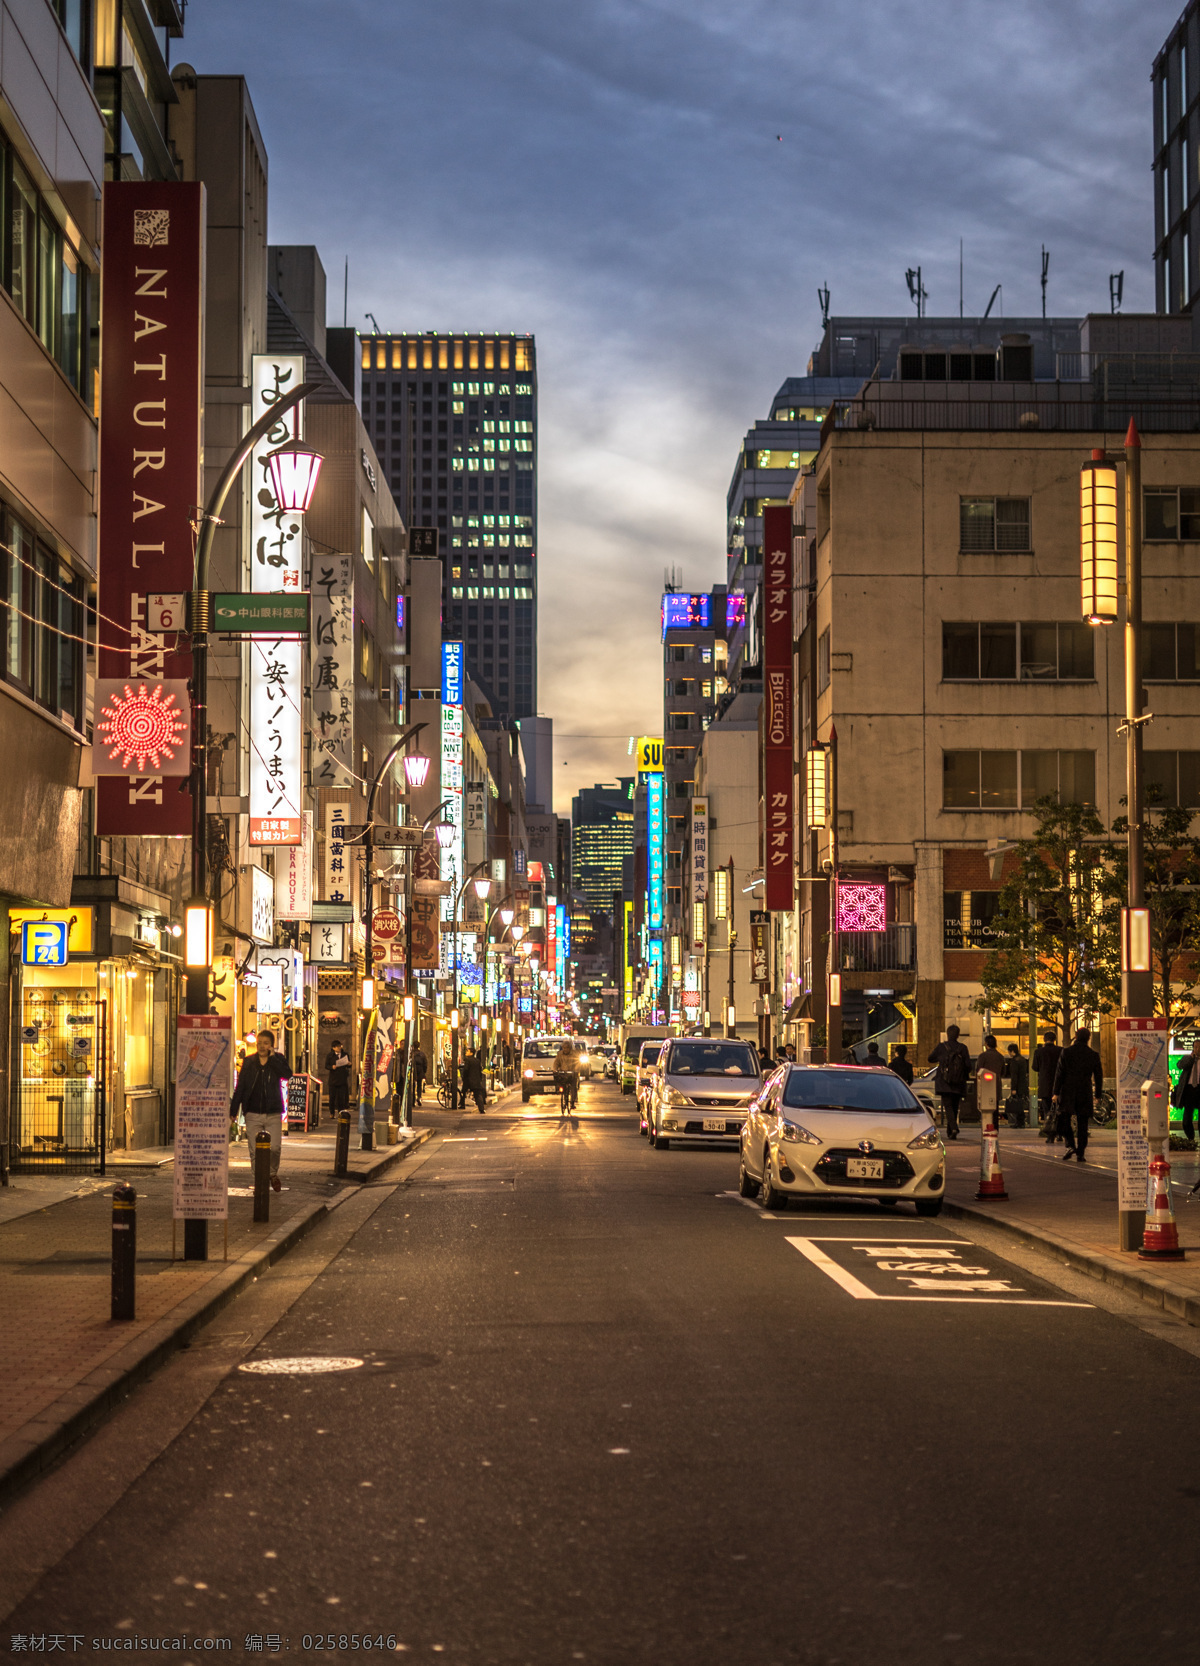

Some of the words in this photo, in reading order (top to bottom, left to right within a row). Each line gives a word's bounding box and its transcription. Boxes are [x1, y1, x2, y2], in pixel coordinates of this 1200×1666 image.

[132, 265, 168, 569] NATURAL
[770, 550, 787, 623] カラオケ
[672, 597, 707, 605] カラオケ
[160, 609, 173, 628] 6
[238, 607, 305, 619] 中山眼科医院
[770, 672, 785, 701] BIG
[444, 709, 454, 721] 16
[771, 703, 785, 744] ECHO
[444, 744, 460, 752] NNT
[643, 744, 664, 766] SU
[261, 820, 289, 830] 自家製
[771, 792, 788, 866] カラオケ
[252, 831, 299, 841] 特製カレー
[384, 829, 416, 841] 日本橋
[694, 821, 706, 869] 時間貸
[289, 872, 297, 911] HOUSE
[374, 919, 399, 931] 消火栓
[321, 927, 334, 957] そば
[37, 946, 59, 962] 24
